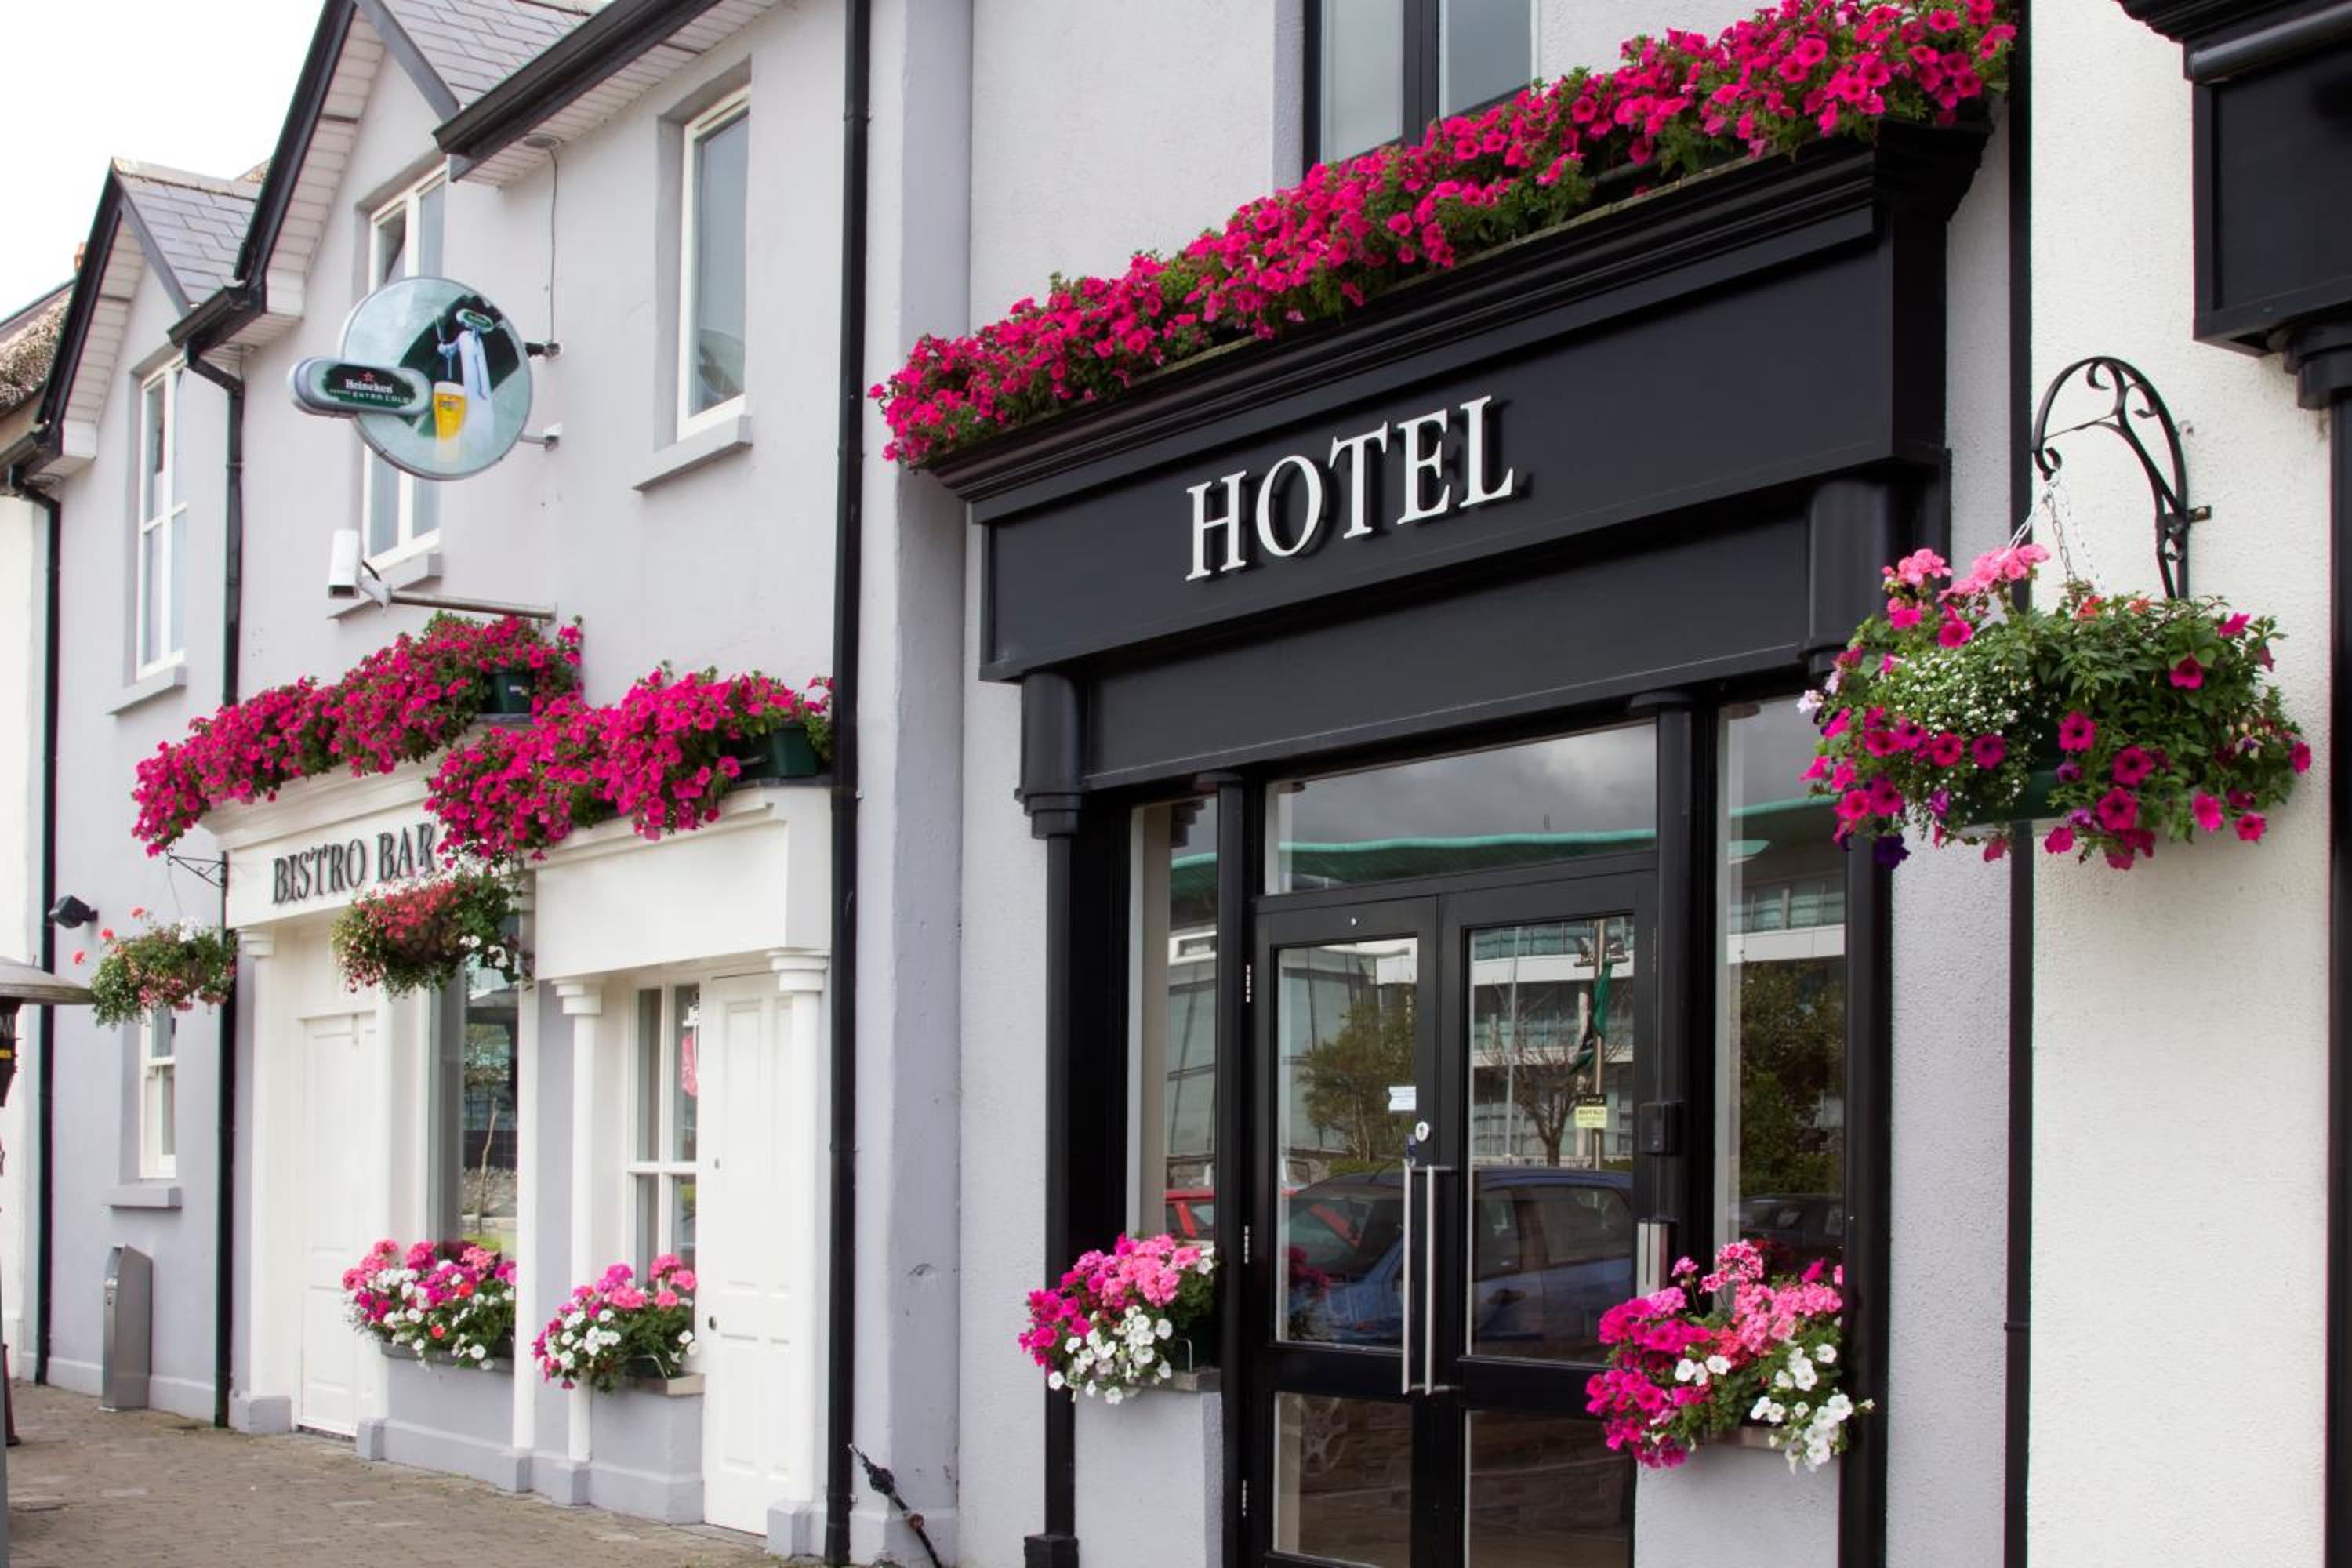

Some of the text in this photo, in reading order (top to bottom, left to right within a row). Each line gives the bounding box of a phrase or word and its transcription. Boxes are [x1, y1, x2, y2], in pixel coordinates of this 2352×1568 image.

[345, 379, 393, 393] Heineken
[1185, 394, 1515, 582] HOTEL
[272, 823, 435, 904] BISTRO BAR
